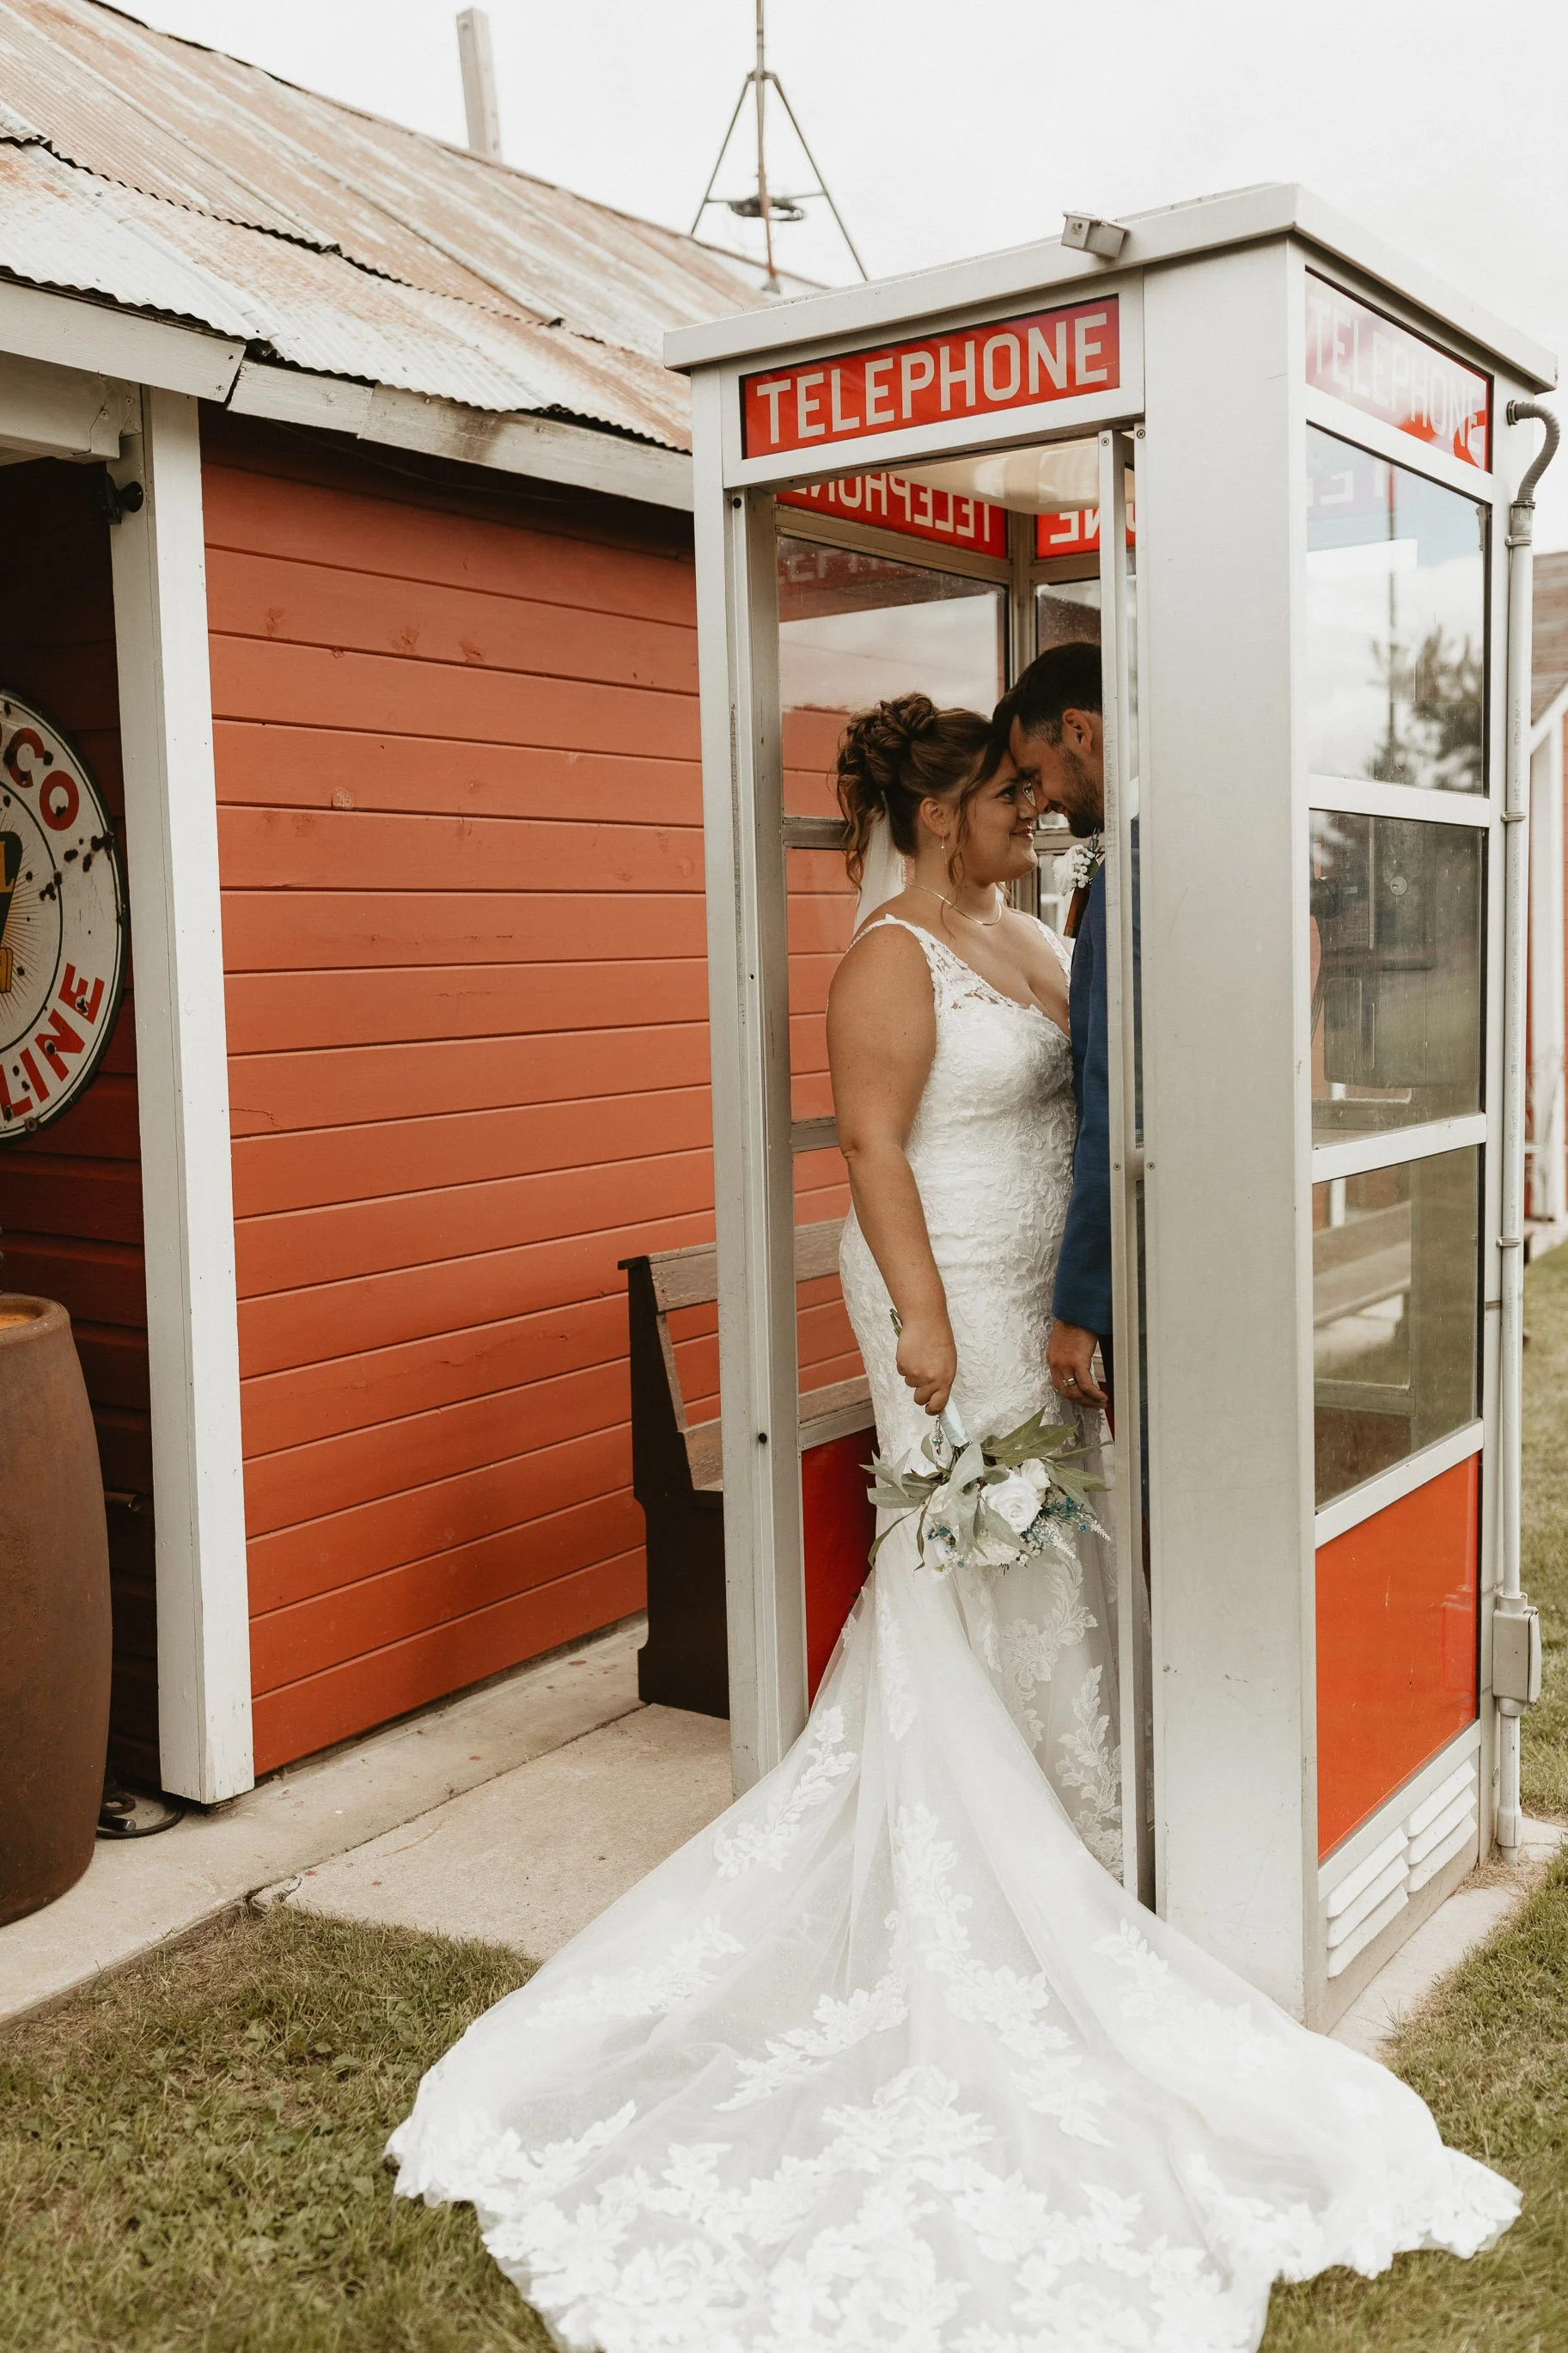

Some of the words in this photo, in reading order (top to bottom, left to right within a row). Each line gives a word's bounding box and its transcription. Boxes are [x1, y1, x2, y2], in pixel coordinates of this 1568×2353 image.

[757, 312, 1107, 445] TELEPHONE
[1308, 295, 1486, 470] TELEPHONE
[0, 720, 81, 832] CO
[0, 962, 106, 1117] LINE
